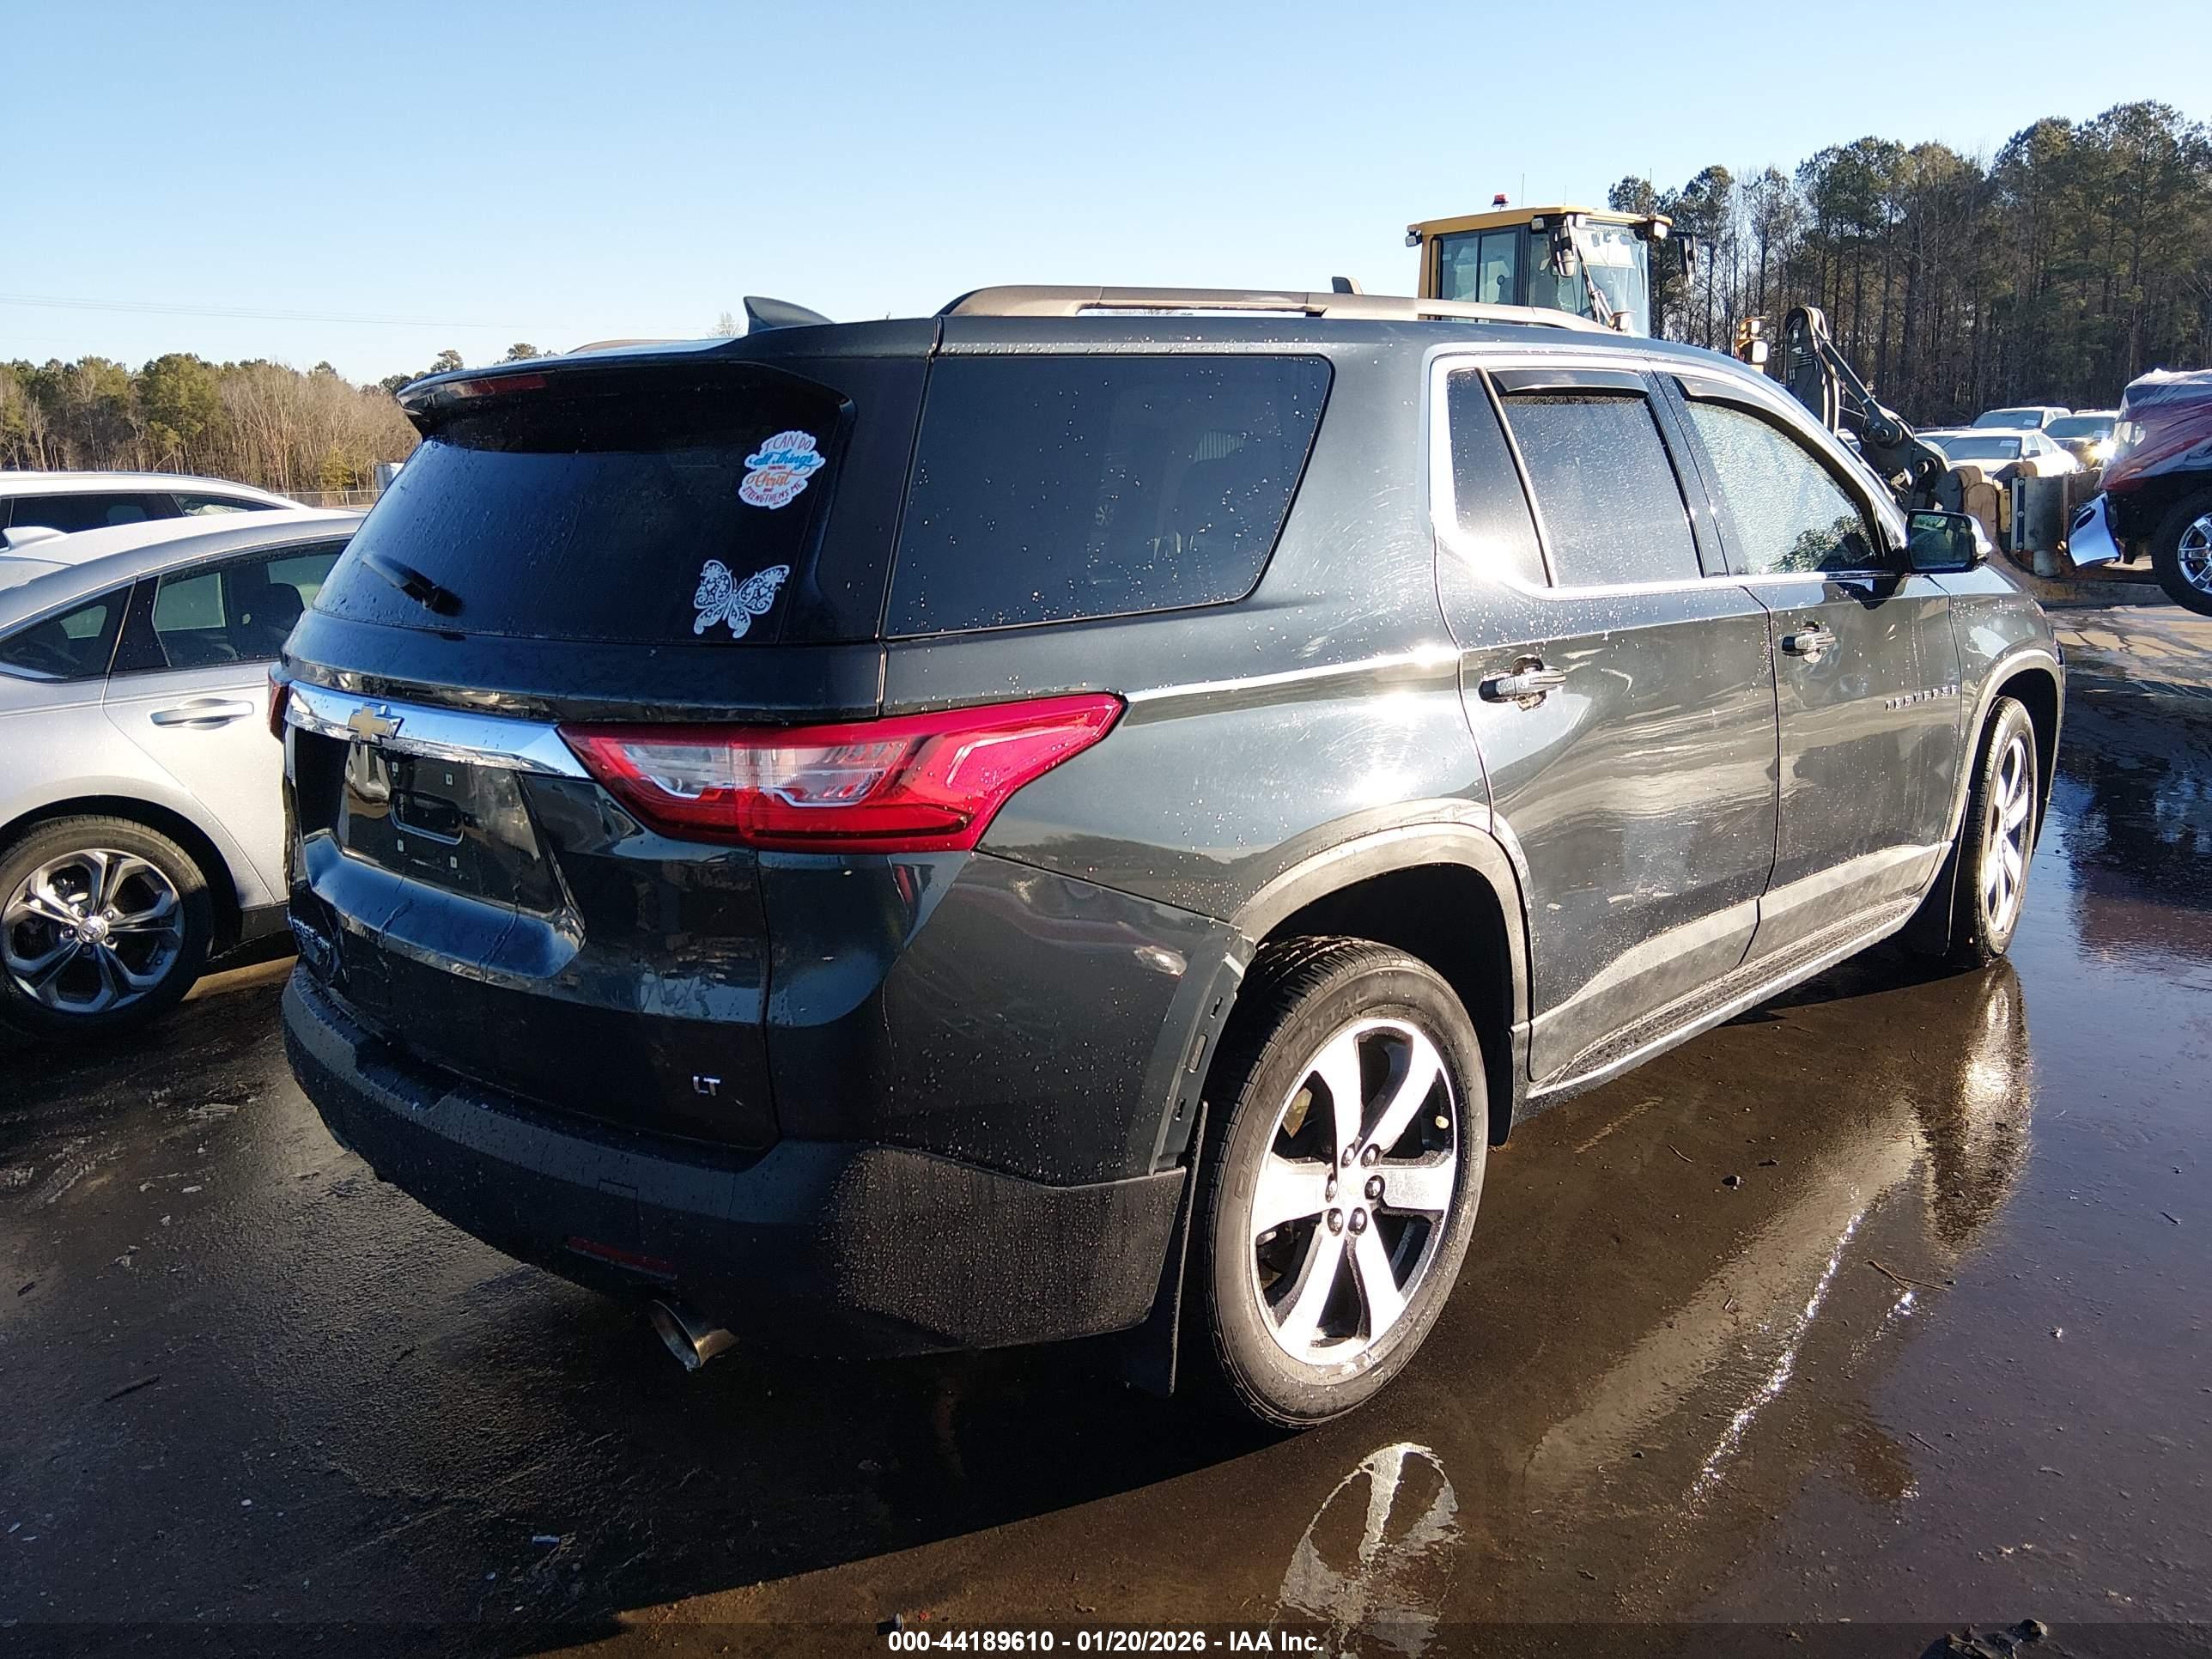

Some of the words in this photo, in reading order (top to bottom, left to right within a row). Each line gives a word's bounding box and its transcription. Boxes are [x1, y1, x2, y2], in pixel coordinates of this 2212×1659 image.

[773, 433, 799, 450] CAN
[797, 436, 812, 451] DO
[790, 480, 803, 493] ME
[692, 1075, 721, 1097] LT
